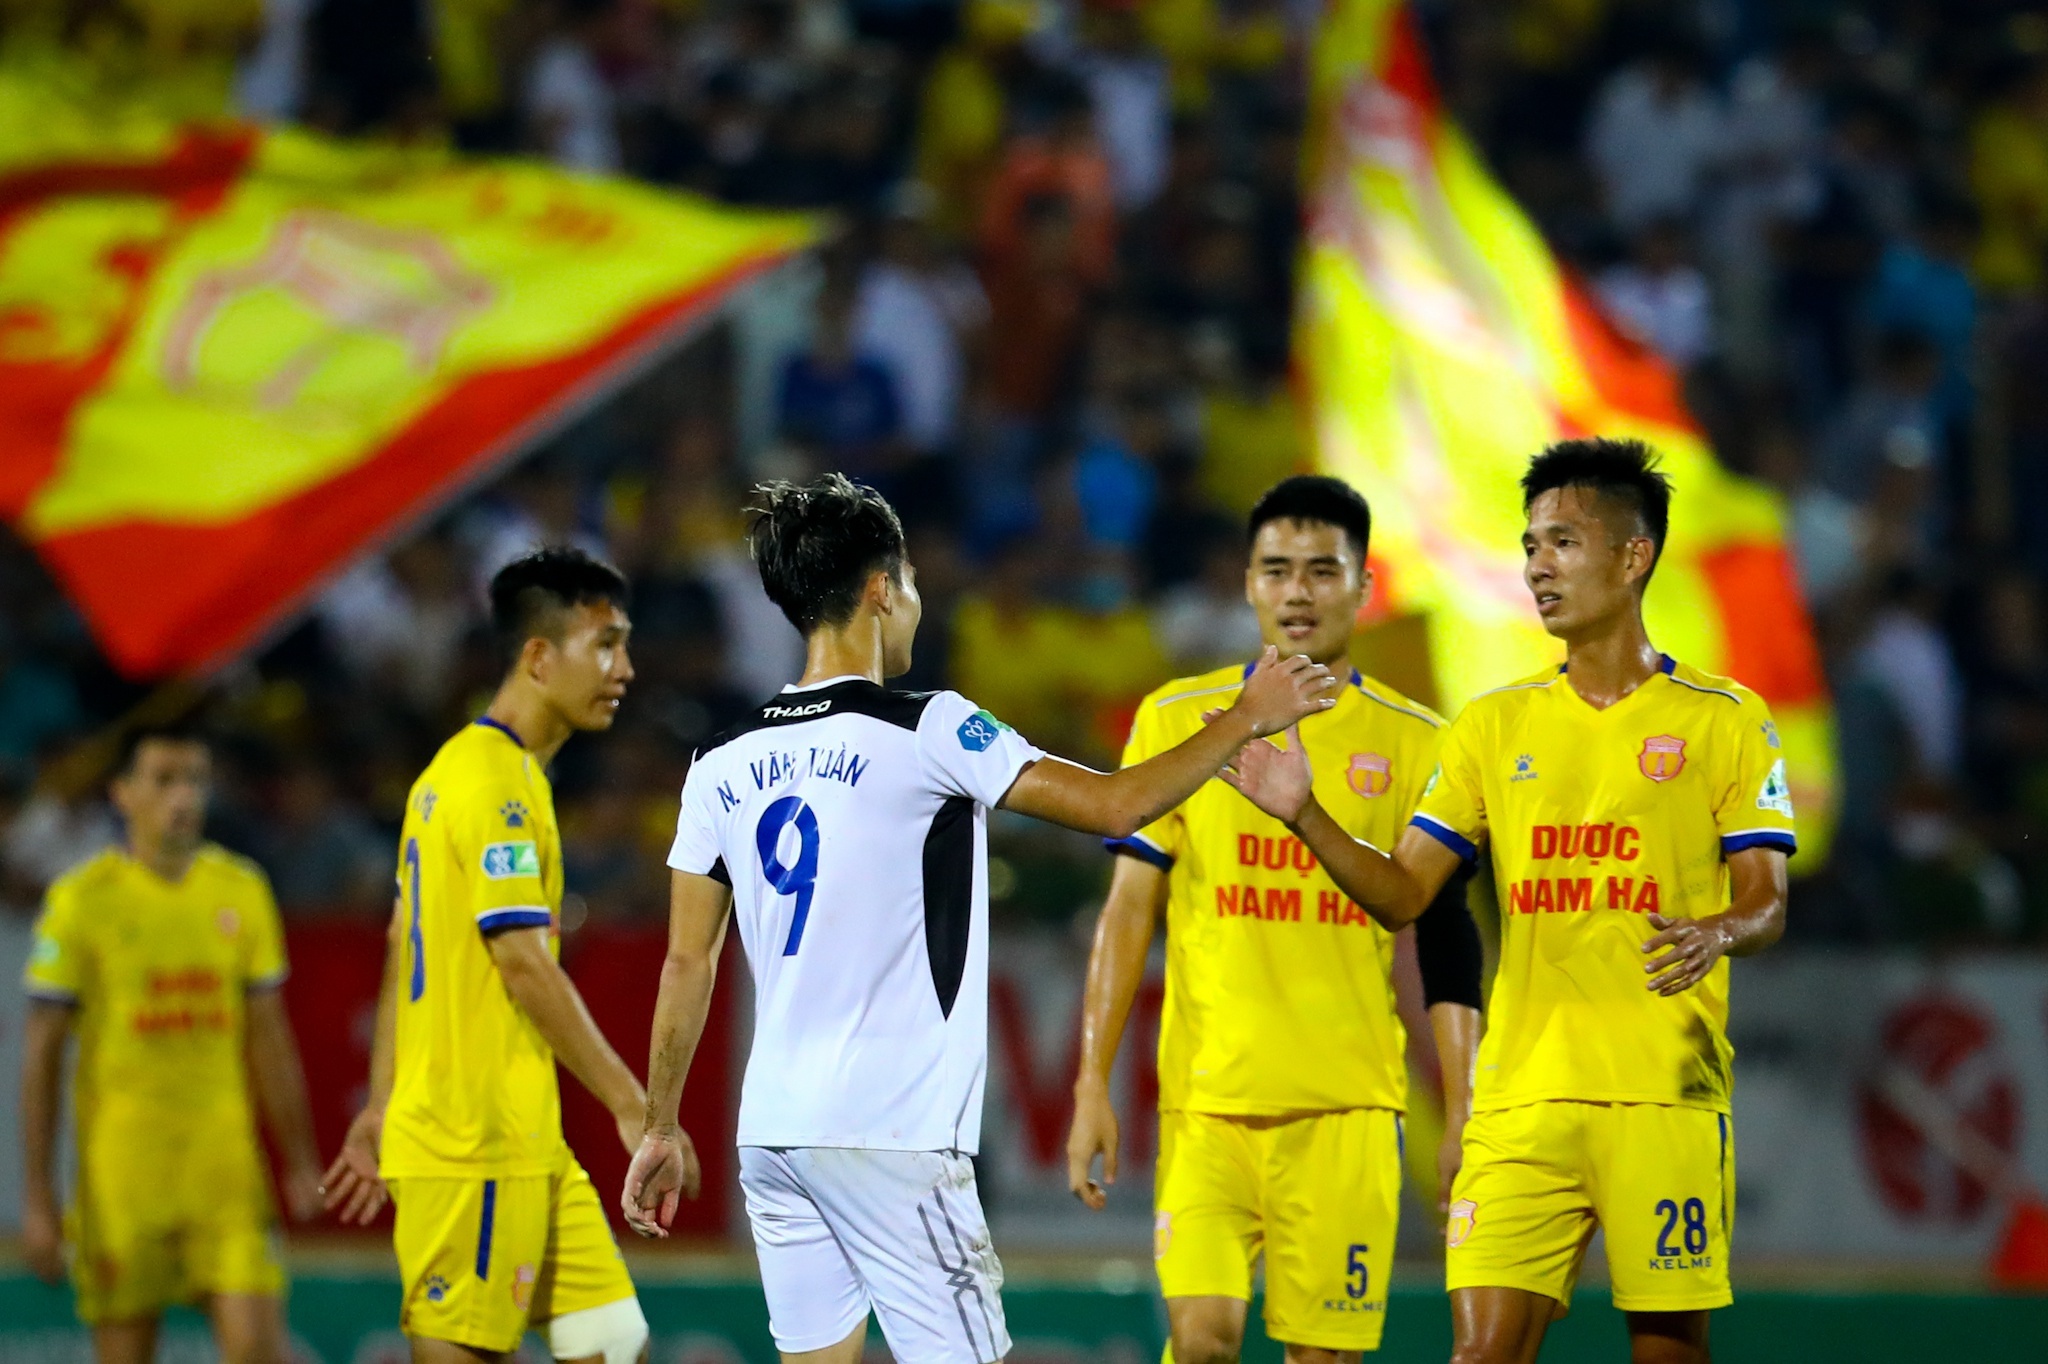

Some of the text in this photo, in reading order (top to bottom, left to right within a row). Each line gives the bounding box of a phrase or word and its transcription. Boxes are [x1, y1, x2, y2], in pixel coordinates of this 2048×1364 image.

[762, 699, 833, 719] THACO
[716, 779, 741, 813] N.
[1531, 821, 1640, 866] DƯỢC
[756, 795, 820, 957] 9
[1509, 874, 1660, 916] NAM HÀ
[1216, 883, 1301, 922] NAM
[1654, 1197, 1708, 1257] 28
[1346, 1244, 1369, 1299] 5
[1648, 1257, 1712, 1270] KELME
